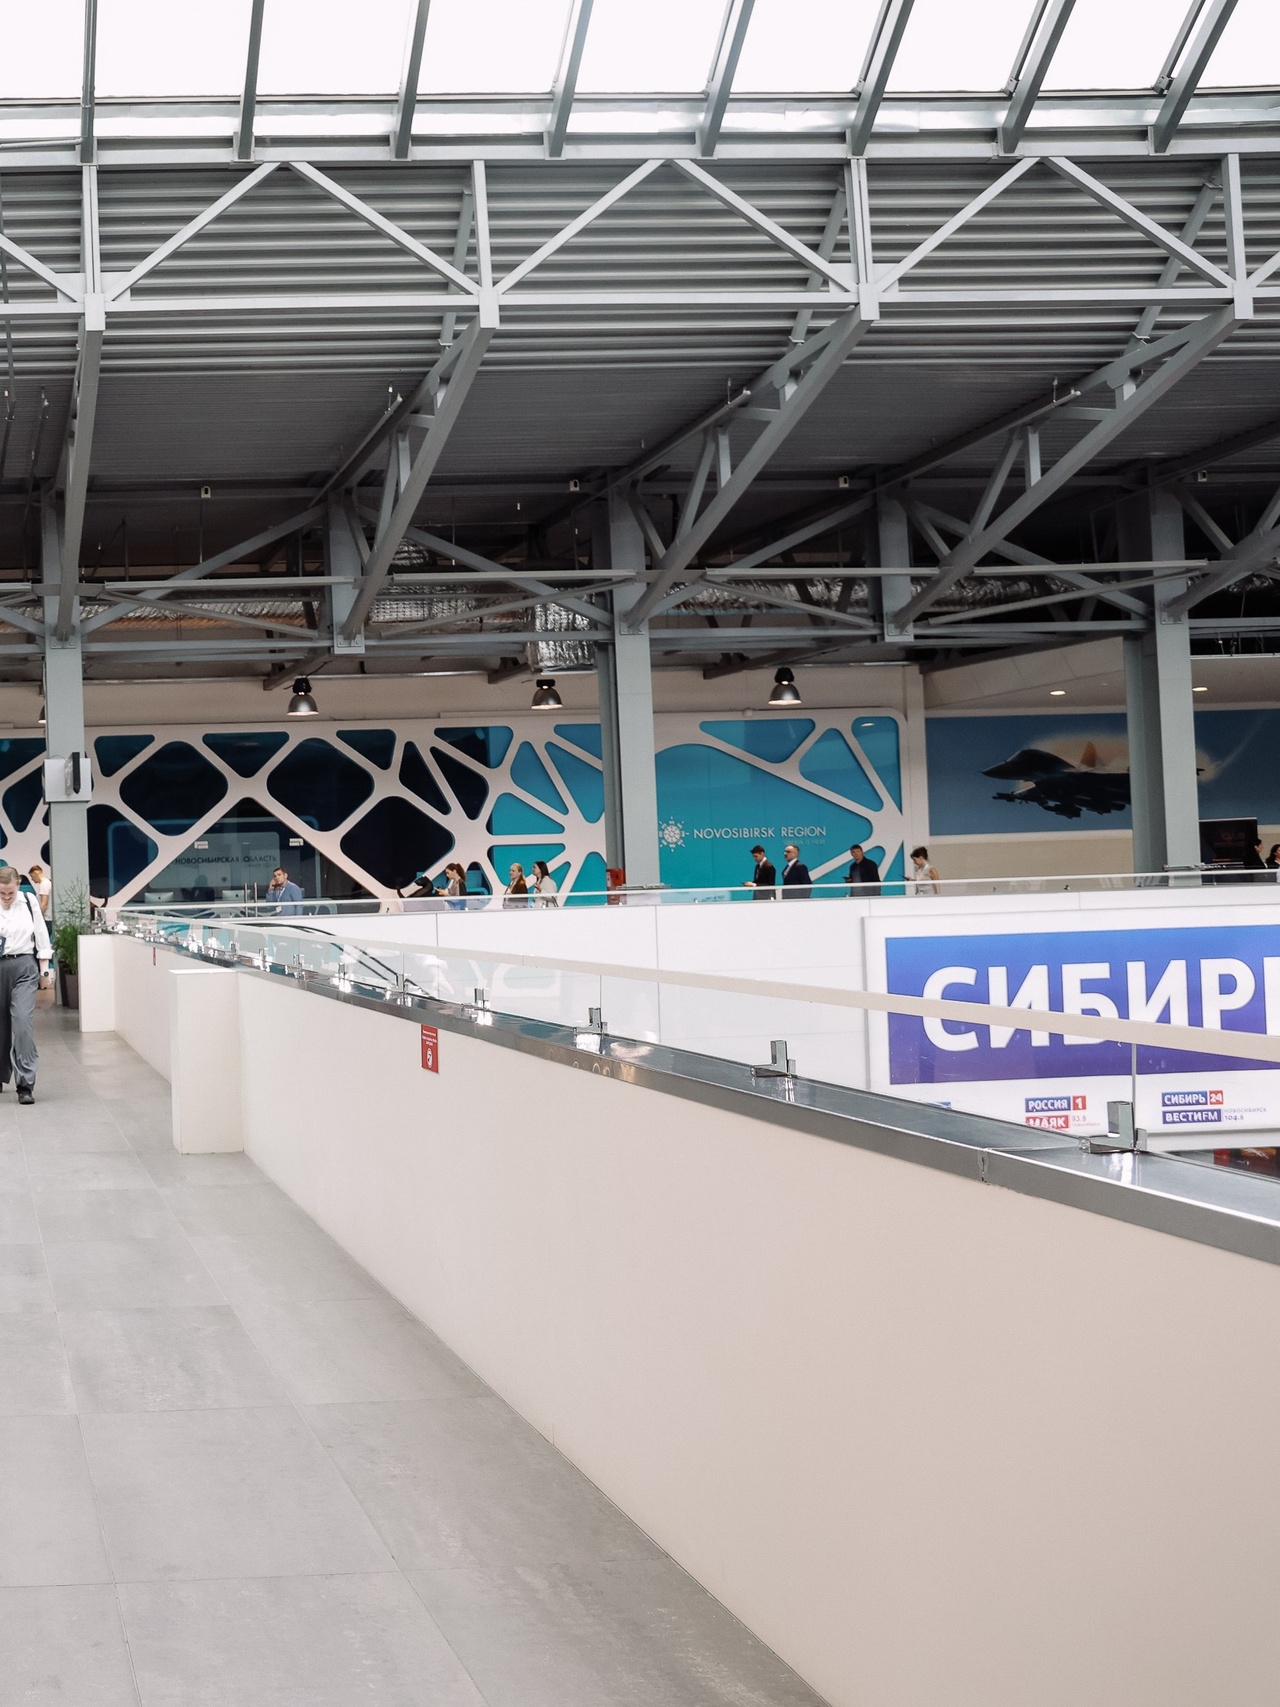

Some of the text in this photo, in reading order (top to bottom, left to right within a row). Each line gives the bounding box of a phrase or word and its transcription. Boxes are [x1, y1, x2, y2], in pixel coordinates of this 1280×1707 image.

[693, 825, 827, 839] NOVOSIBIRSK REGION
[1028, 1097, 1083, 1111] РОССИЯ 1
[1164, 1093, 1222, 1105] СИБИРЬ 24
[1028, 1117, 1066, 1129] МАЯК
